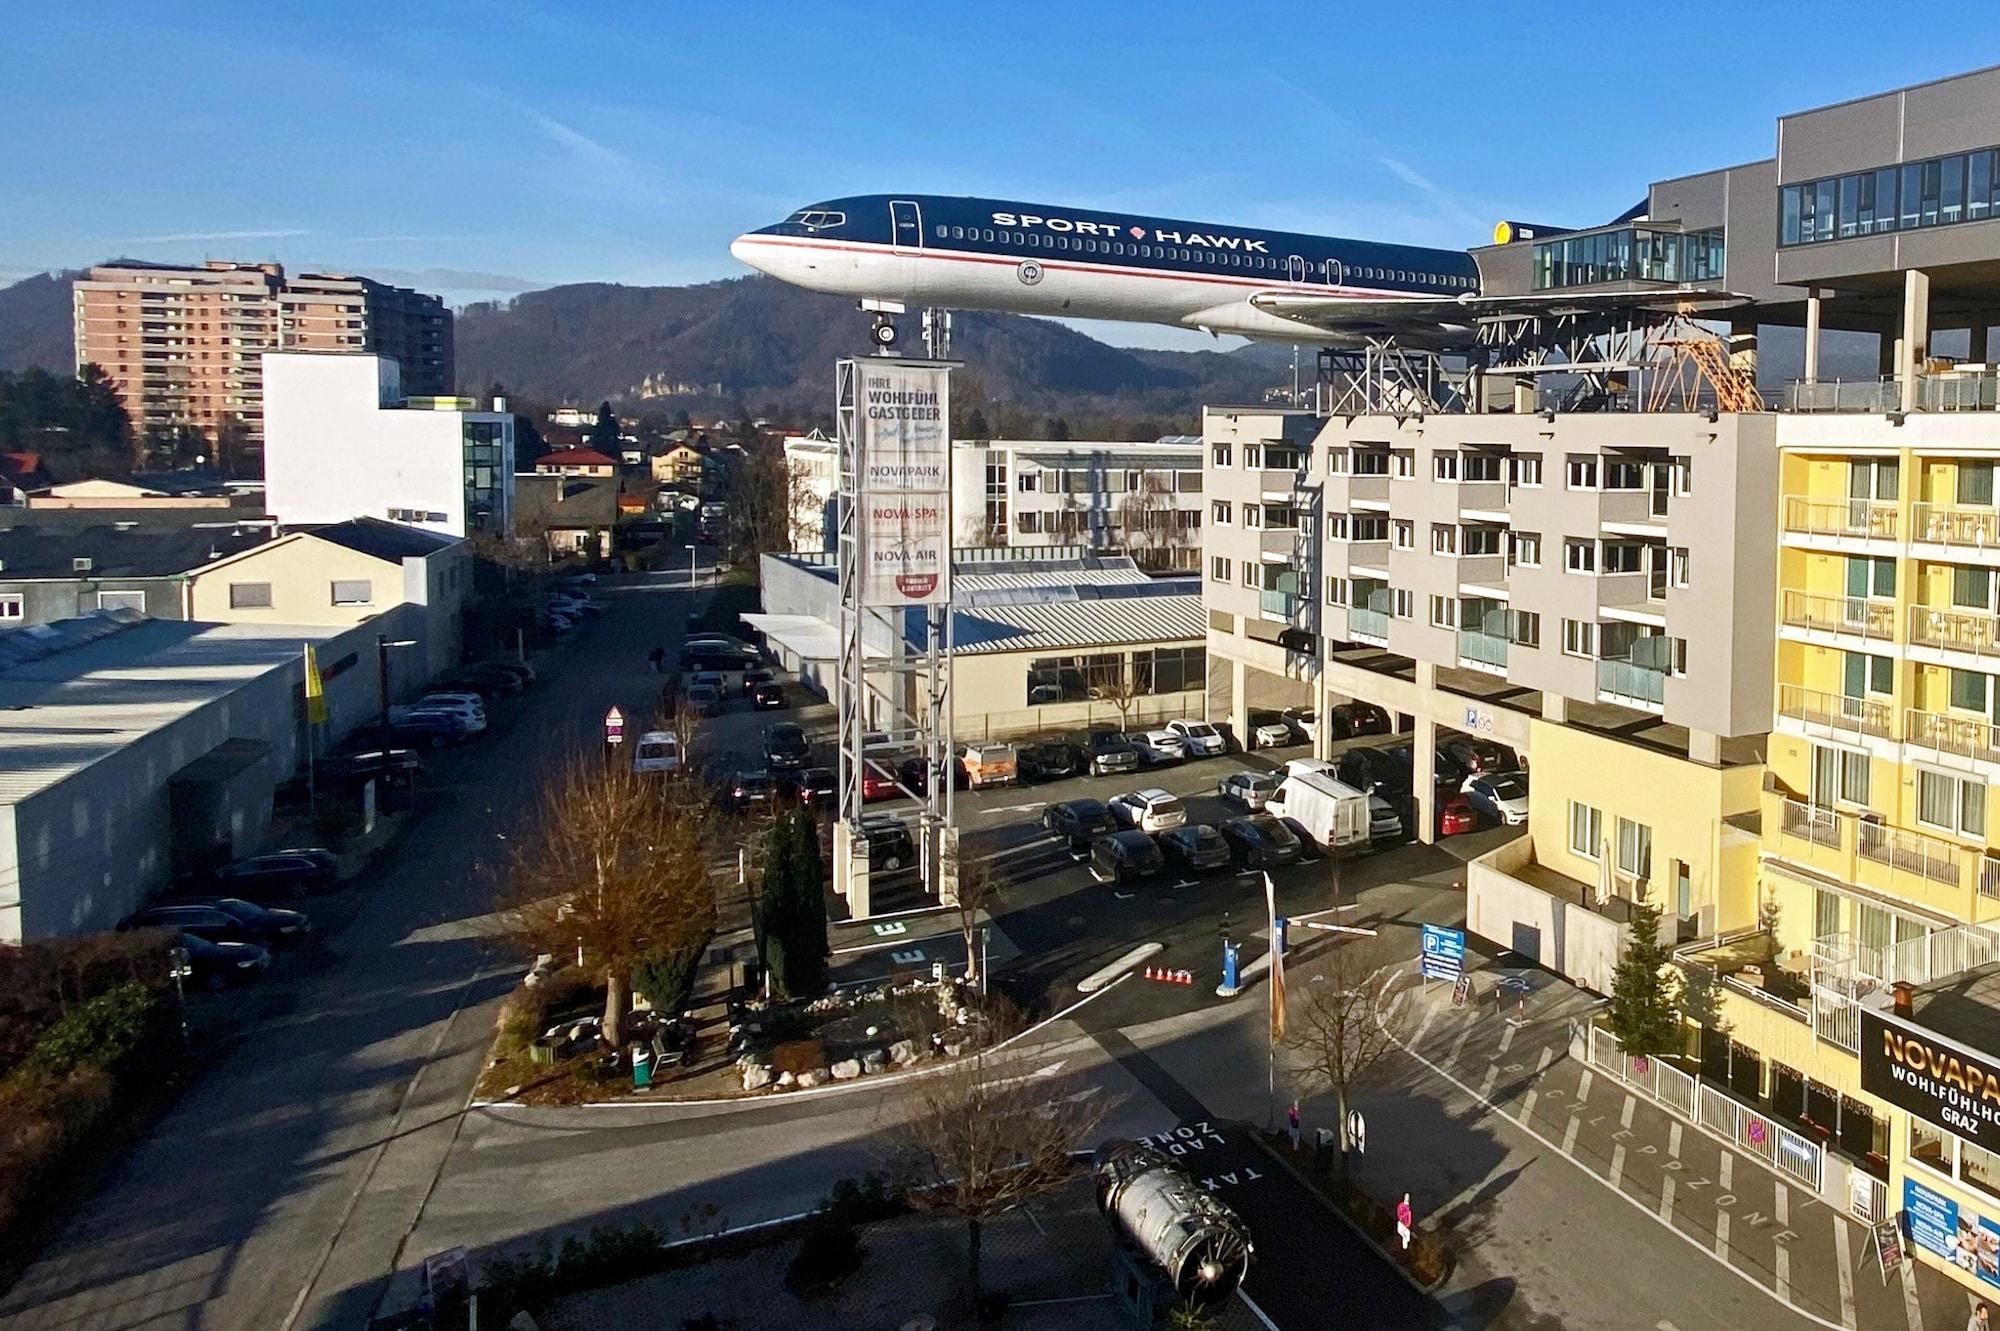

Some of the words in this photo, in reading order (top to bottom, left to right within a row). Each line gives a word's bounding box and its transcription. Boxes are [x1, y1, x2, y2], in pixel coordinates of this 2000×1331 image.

[991, 212, 1121, 237] SPORT
[1154, 229, 1270, 254] HAWK
[868, 377, 891, 389] IHRE
[868, 388, 939, 406] WOHLFÜHL
[868, 405, 941, 421] GASTGEBER
[870, 465, 940, 477] NOVAPARK
[874, 550, 937, 561] NOVA-AIR
[1941, 1106, 1978, 1135] GRAZ
[1137, 1122, 1215, 1151] ZONE
